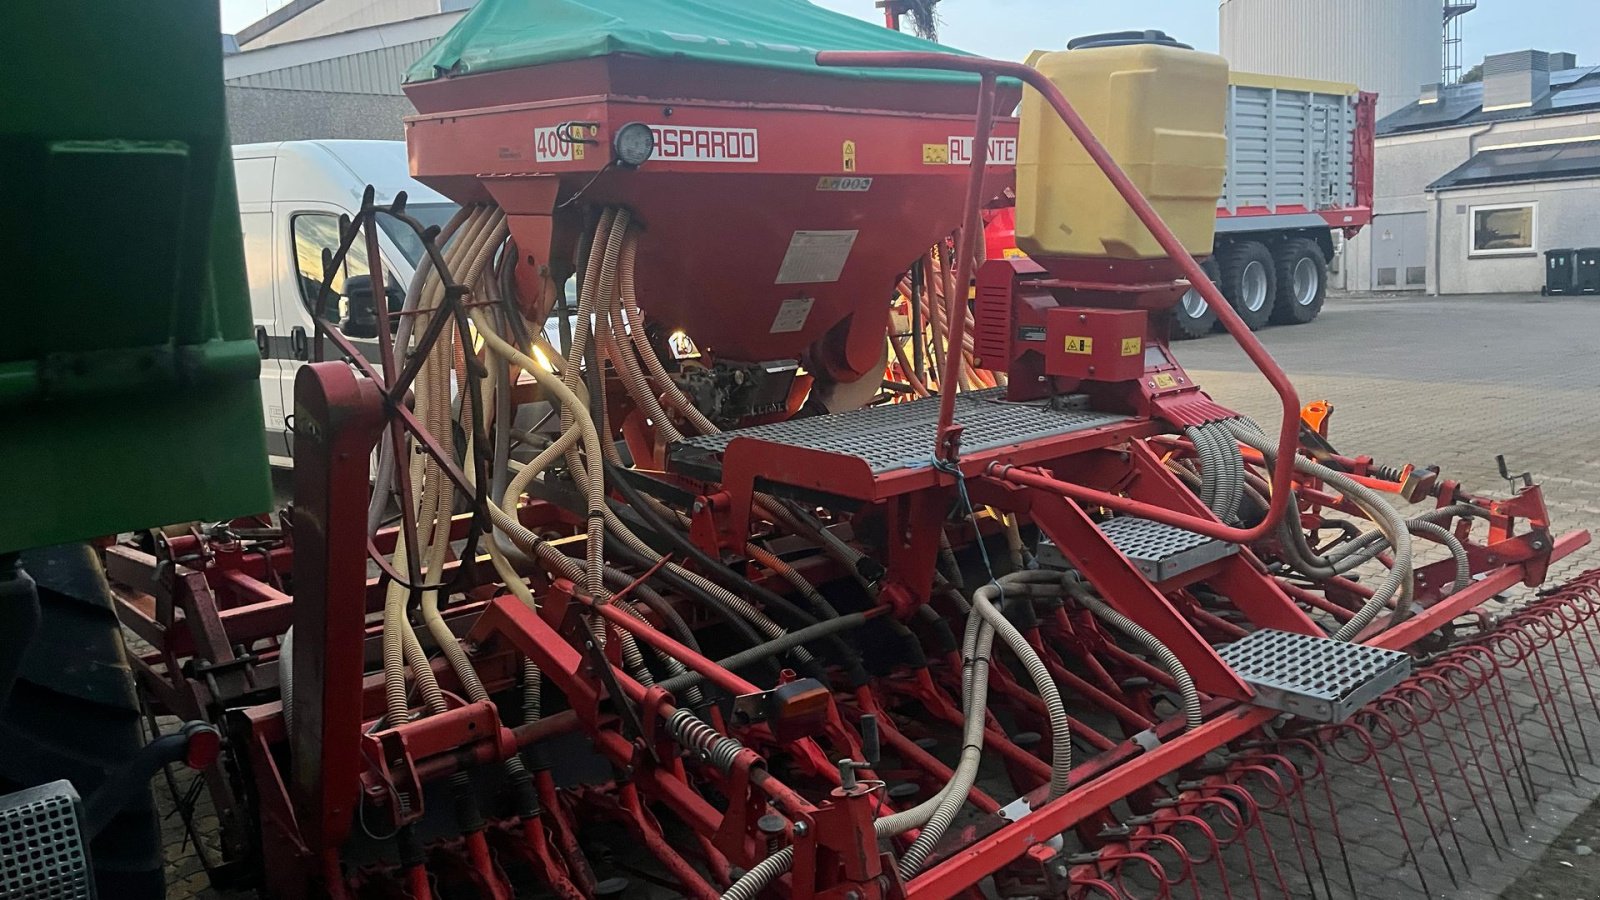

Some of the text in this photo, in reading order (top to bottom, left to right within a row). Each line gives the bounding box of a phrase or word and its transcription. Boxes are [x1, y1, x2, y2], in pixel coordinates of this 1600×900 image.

[537, 130, 570, 158] 400
[651, 128, 755, 158] ASPARDO
[950, 139, 1015, 162] ALNTE
